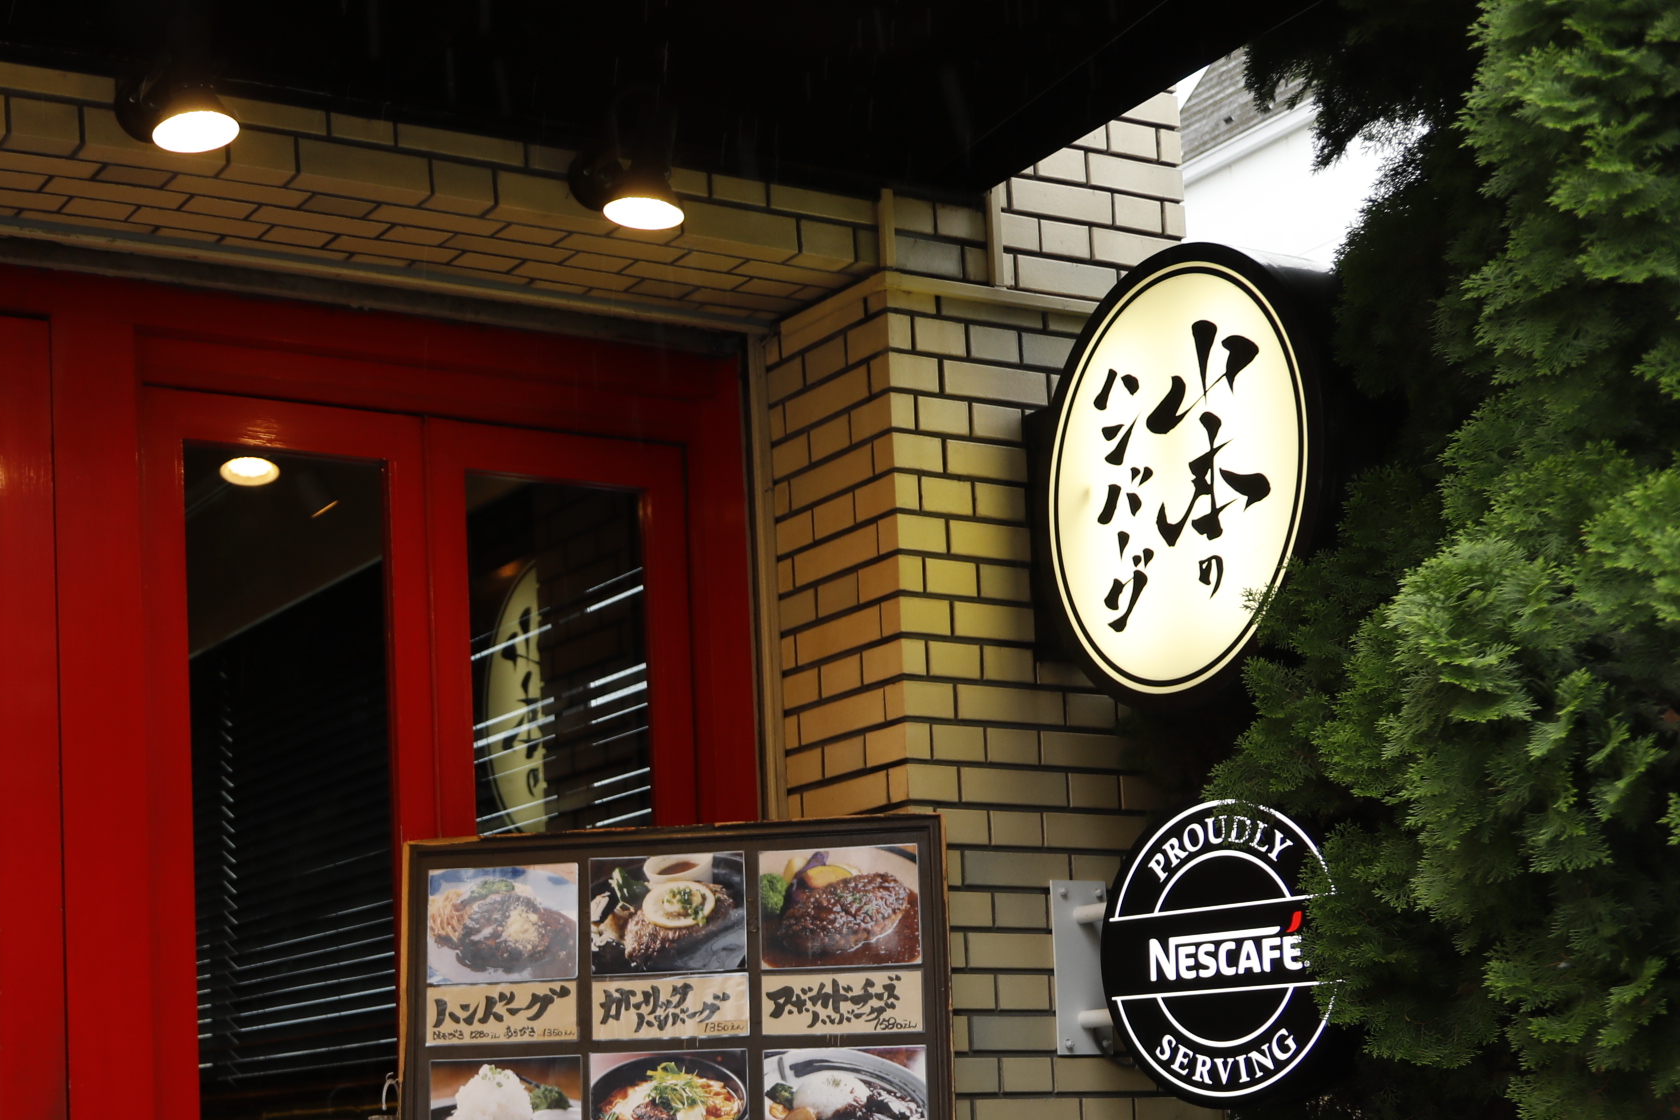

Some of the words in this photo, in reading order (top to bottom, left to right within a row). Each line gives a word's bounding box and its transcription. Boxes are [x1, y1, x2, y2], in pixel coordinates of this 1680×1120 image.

[1146, 319, 1272, 600] 山本の
[1093, 368, 1154, 633] ハンバーグ
[1148, 815, 1294, 884] PROUDLY
[1149, 910, 1304, 983] NESCAFÉ
[432, 984, 572, 1028] ハンバーグ
[633, 991, 731, 1034] ハンバーグ
[1155, 1028, 1298, 1086] SERVING
